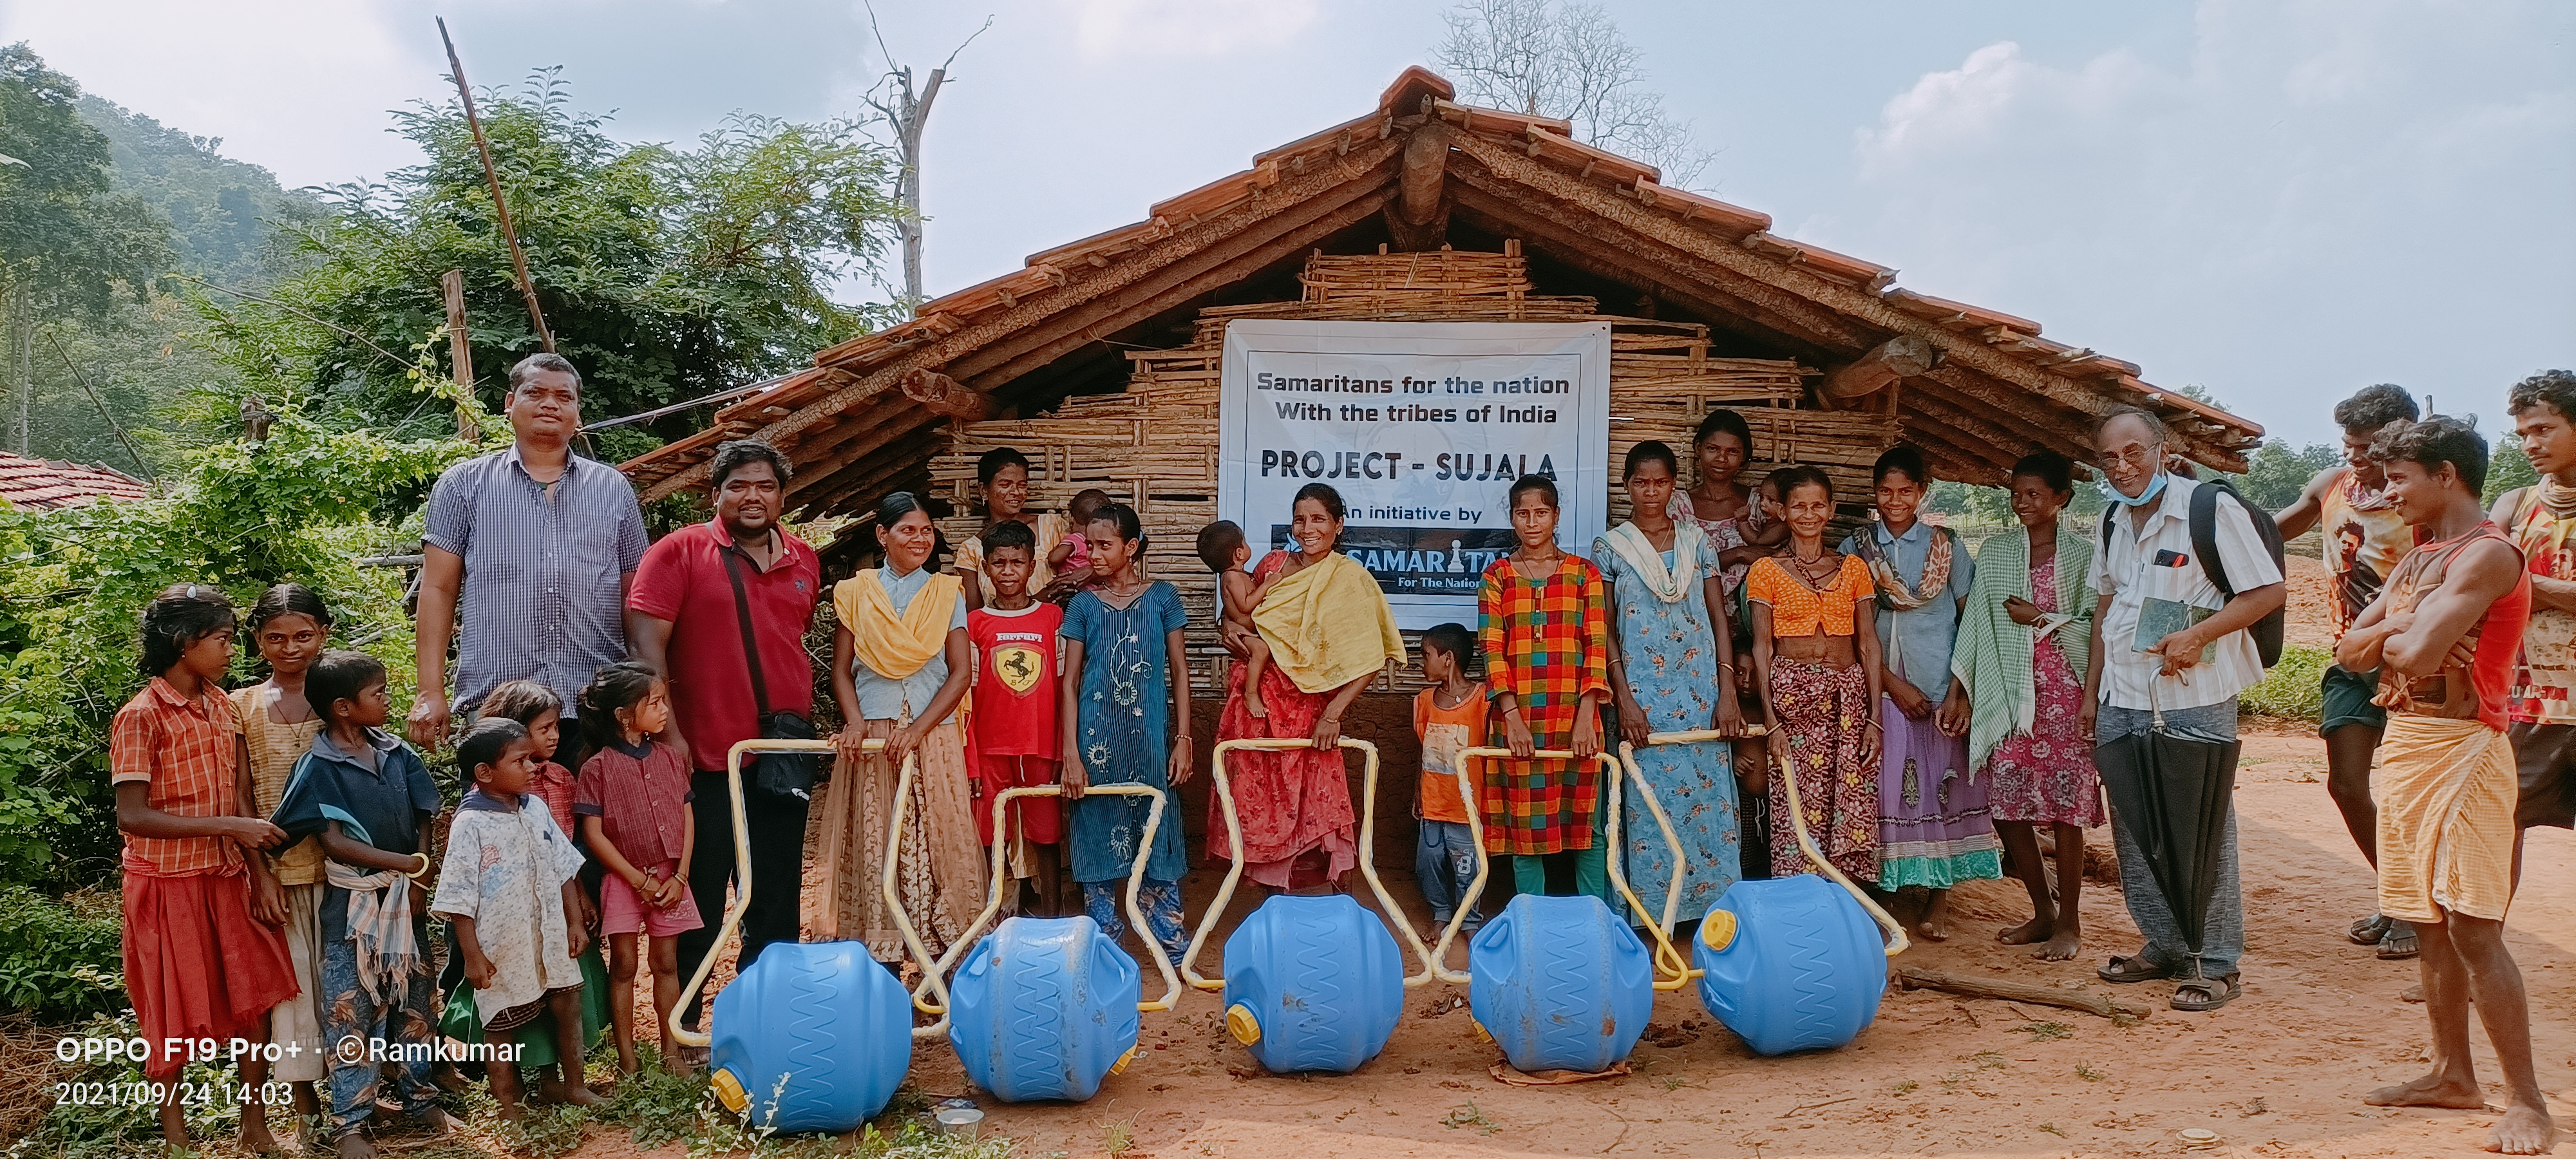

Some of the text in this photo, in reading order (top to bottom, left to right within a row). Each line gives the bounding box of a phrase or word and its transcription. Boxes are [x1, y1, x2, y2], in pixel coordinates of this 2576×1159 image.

[1258, 372, 1569, 394] Samaritans for the nation
[1275, 402, 1557, 423] With the tribes of India
[1262, 450, 1401, 480] PROJECT
[1435, 453, 1558, 482] SUJALA
[1370, 505, 1451, 520] initiative
[1459, 507, 1482, 524] by
[1398, 577, 1417, 587] For
[1420, 578, 1443, 588] The
